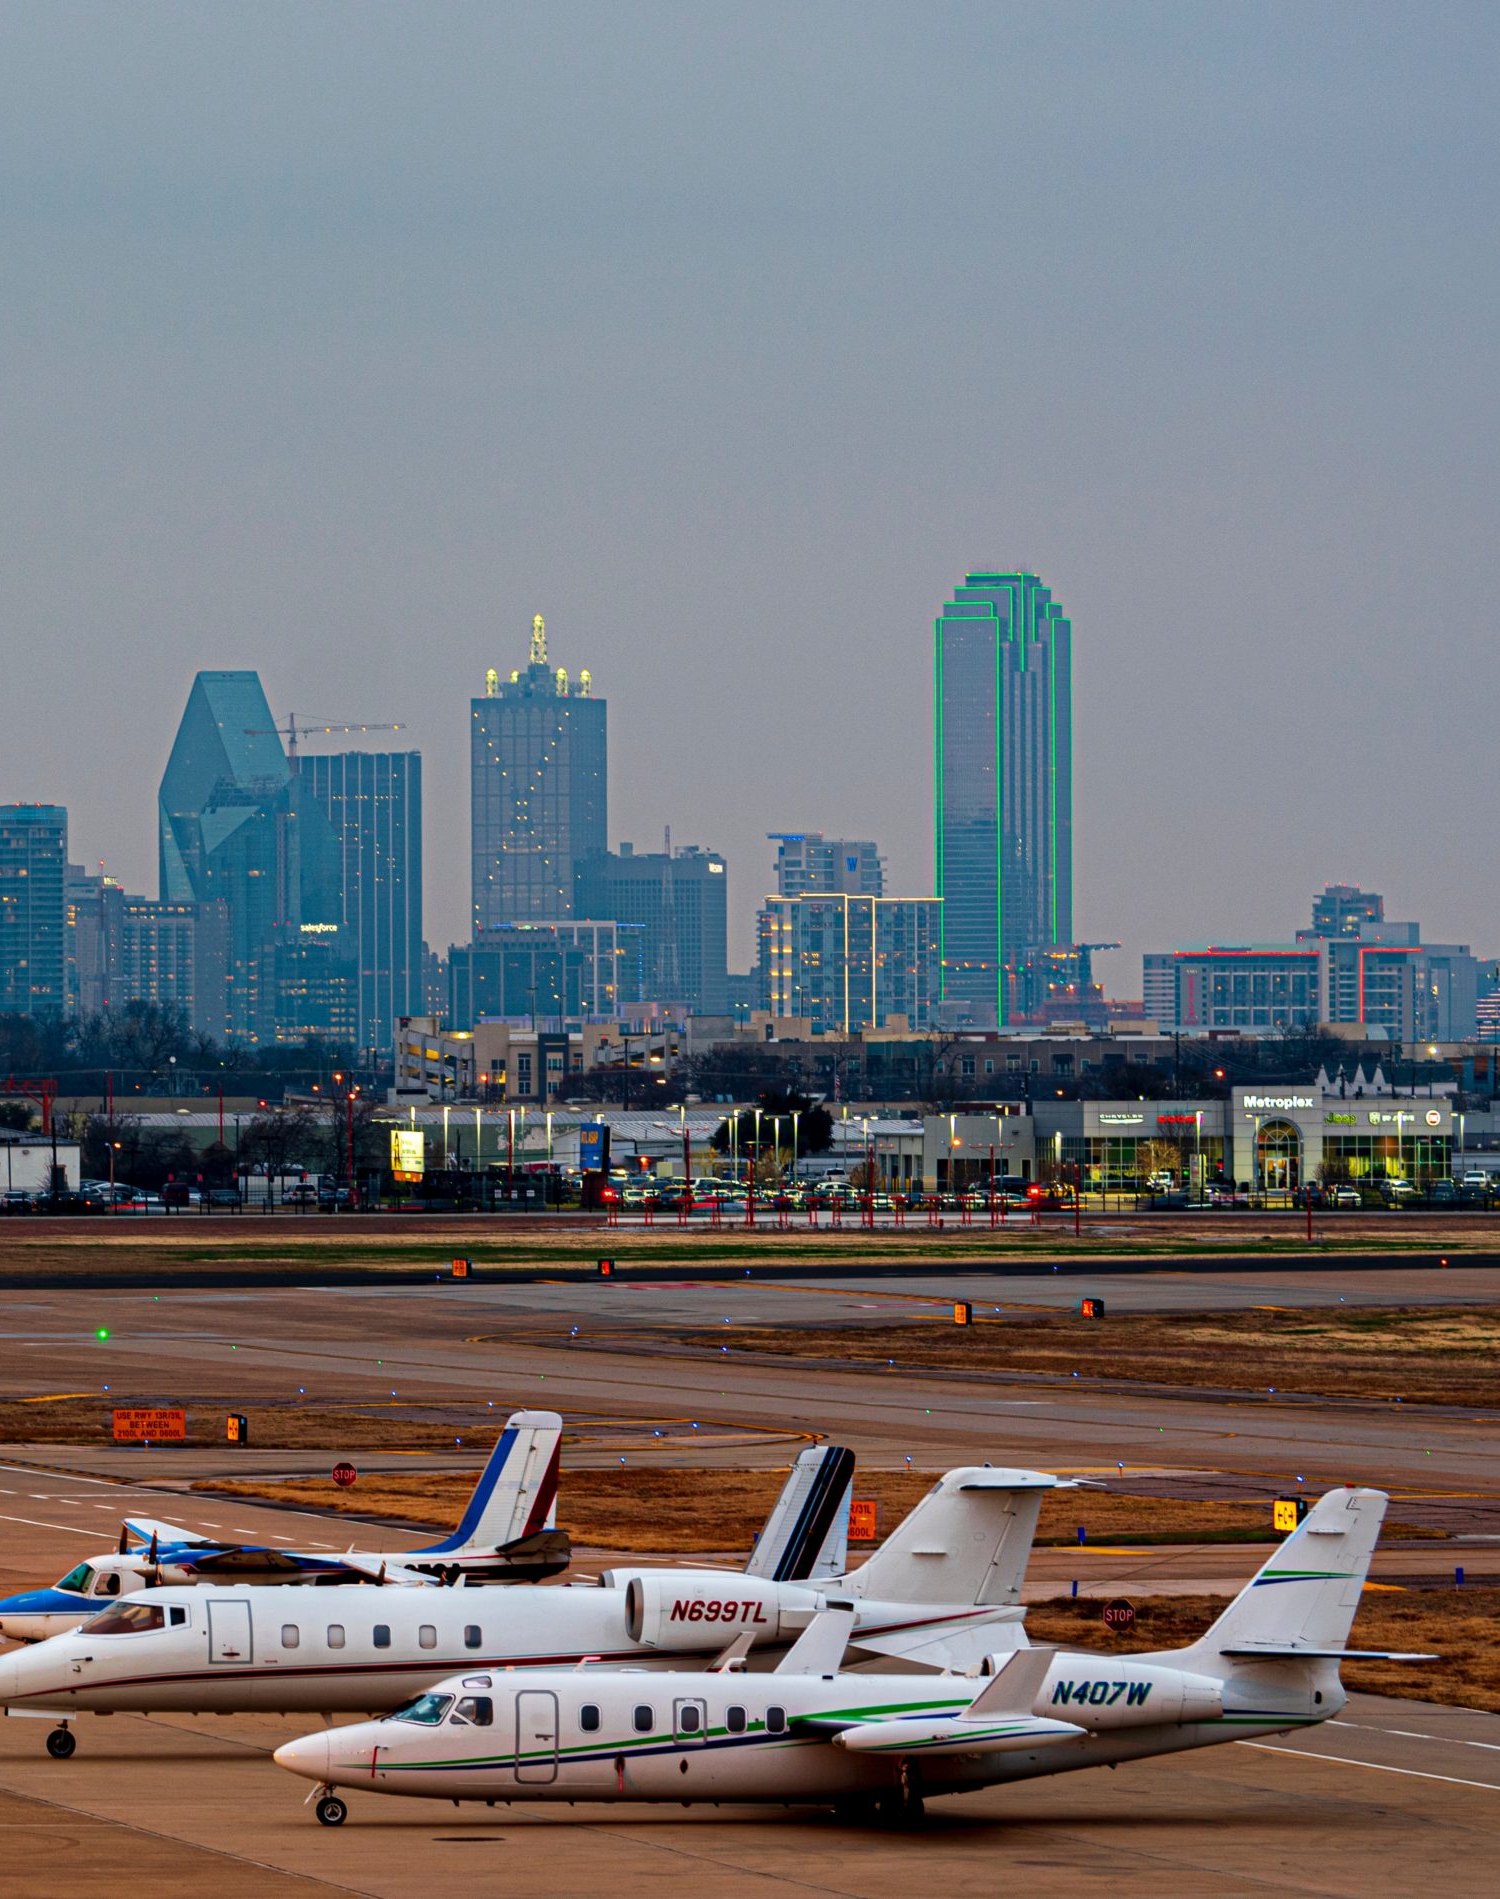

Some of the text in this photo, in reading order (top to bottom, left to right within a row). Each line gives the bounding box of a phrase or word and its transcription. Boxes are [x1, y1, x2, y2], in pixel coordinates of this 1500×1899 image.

[300, 923, 338, 933] salesforce
[1243, 1096, 1313, 1109] Metroplex
[1324, 1112, 1357, 1126] Jeep
[334, 1470, 356, 1480] STOP
[849, 1527, 871, 1537] 600L
[670, 1600, 767, 1623] N699TL
[1105, 1609, 1133, 1622] STOP
[1051, 1681, 1153, 1706] N407W
